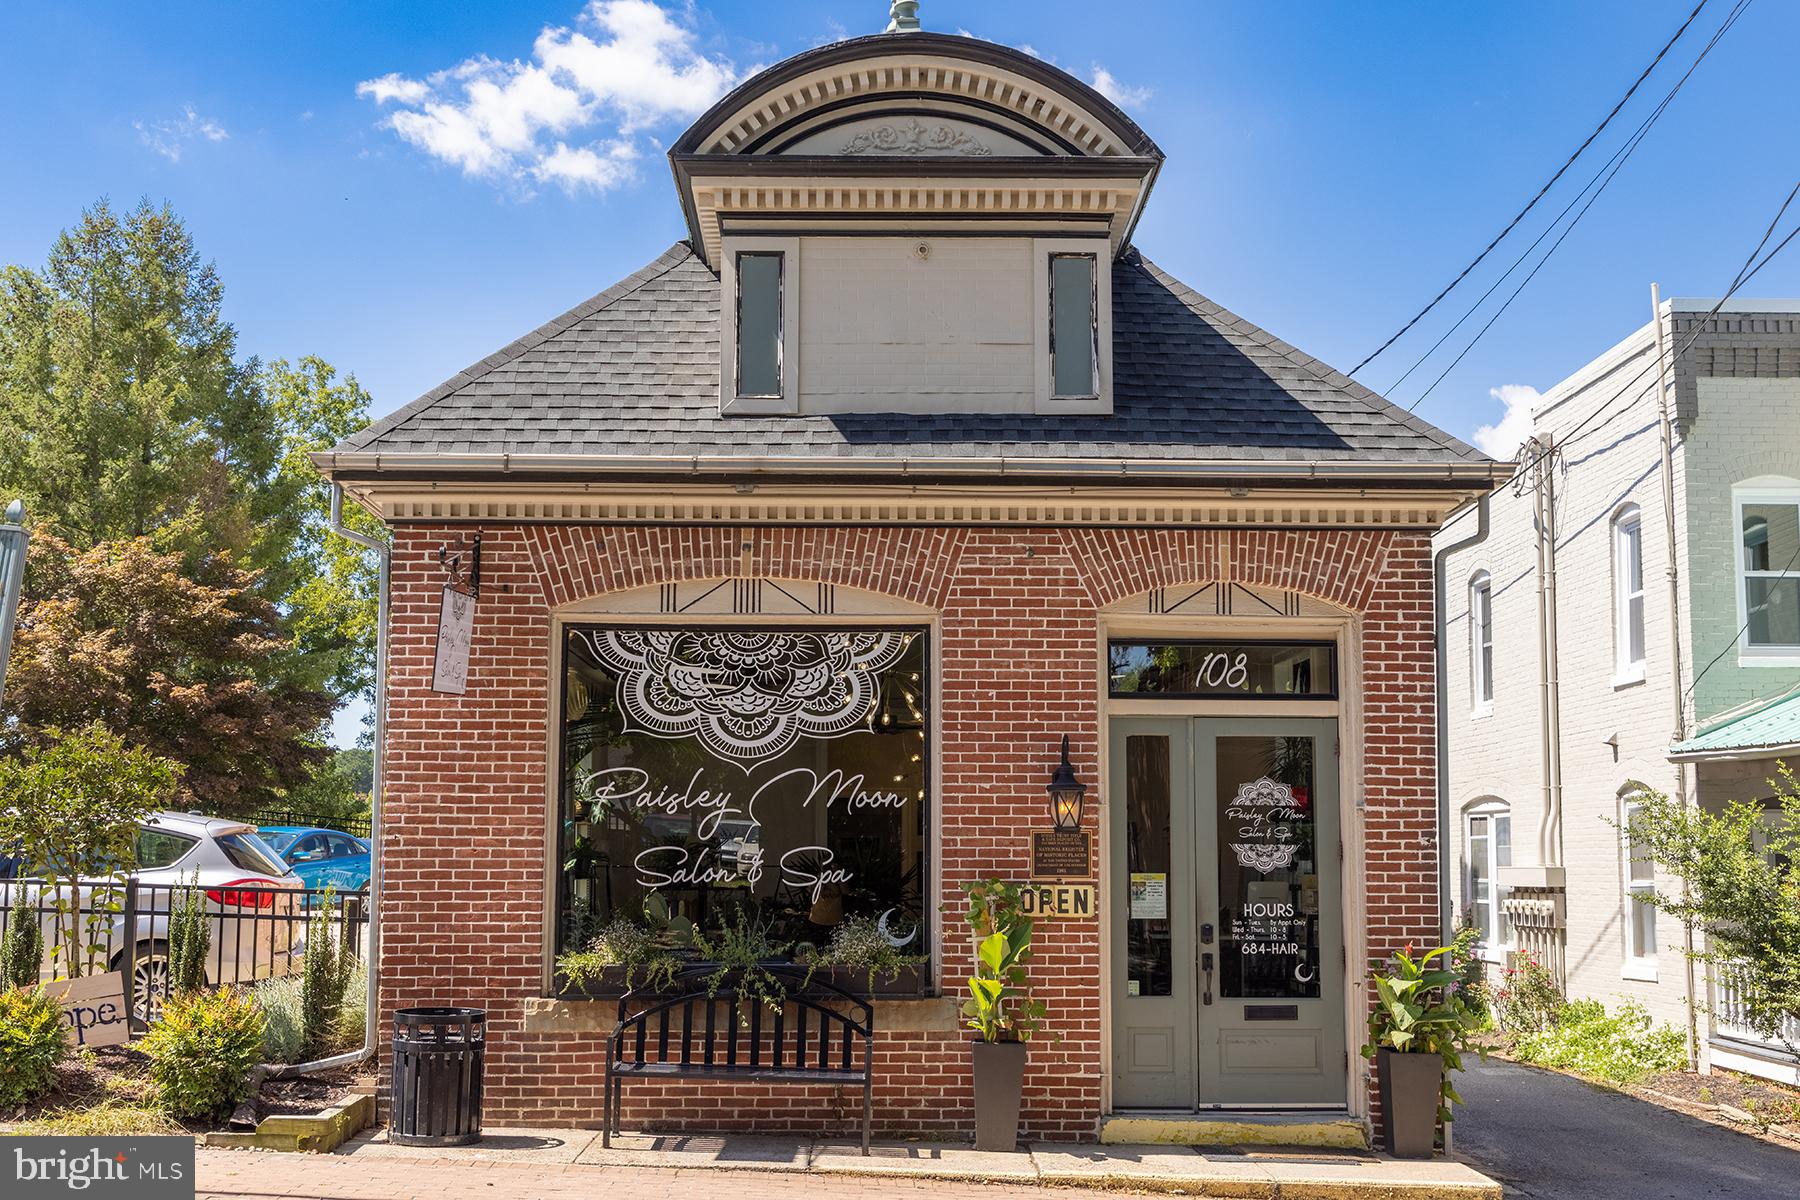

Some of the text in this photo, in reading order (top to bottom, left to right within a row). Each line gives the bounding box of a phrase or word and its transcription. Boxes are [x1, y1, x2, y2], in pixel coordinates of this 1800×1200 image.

[1195, 652, 1247, 689] 108
[584, 767, 908, 841] Paisley Moon
[1225, 807, 1306, 827] Paisley Moon
[1239, 826, 1293, 842] Salon & Spa
[633, 846, 854, 903] Salon & Spa
[1020, 888, 1088, 914] OPEN
[1244, 903, 1294, 917] HOURS
[1241, 942, 1298, 954] 684-HAIR
